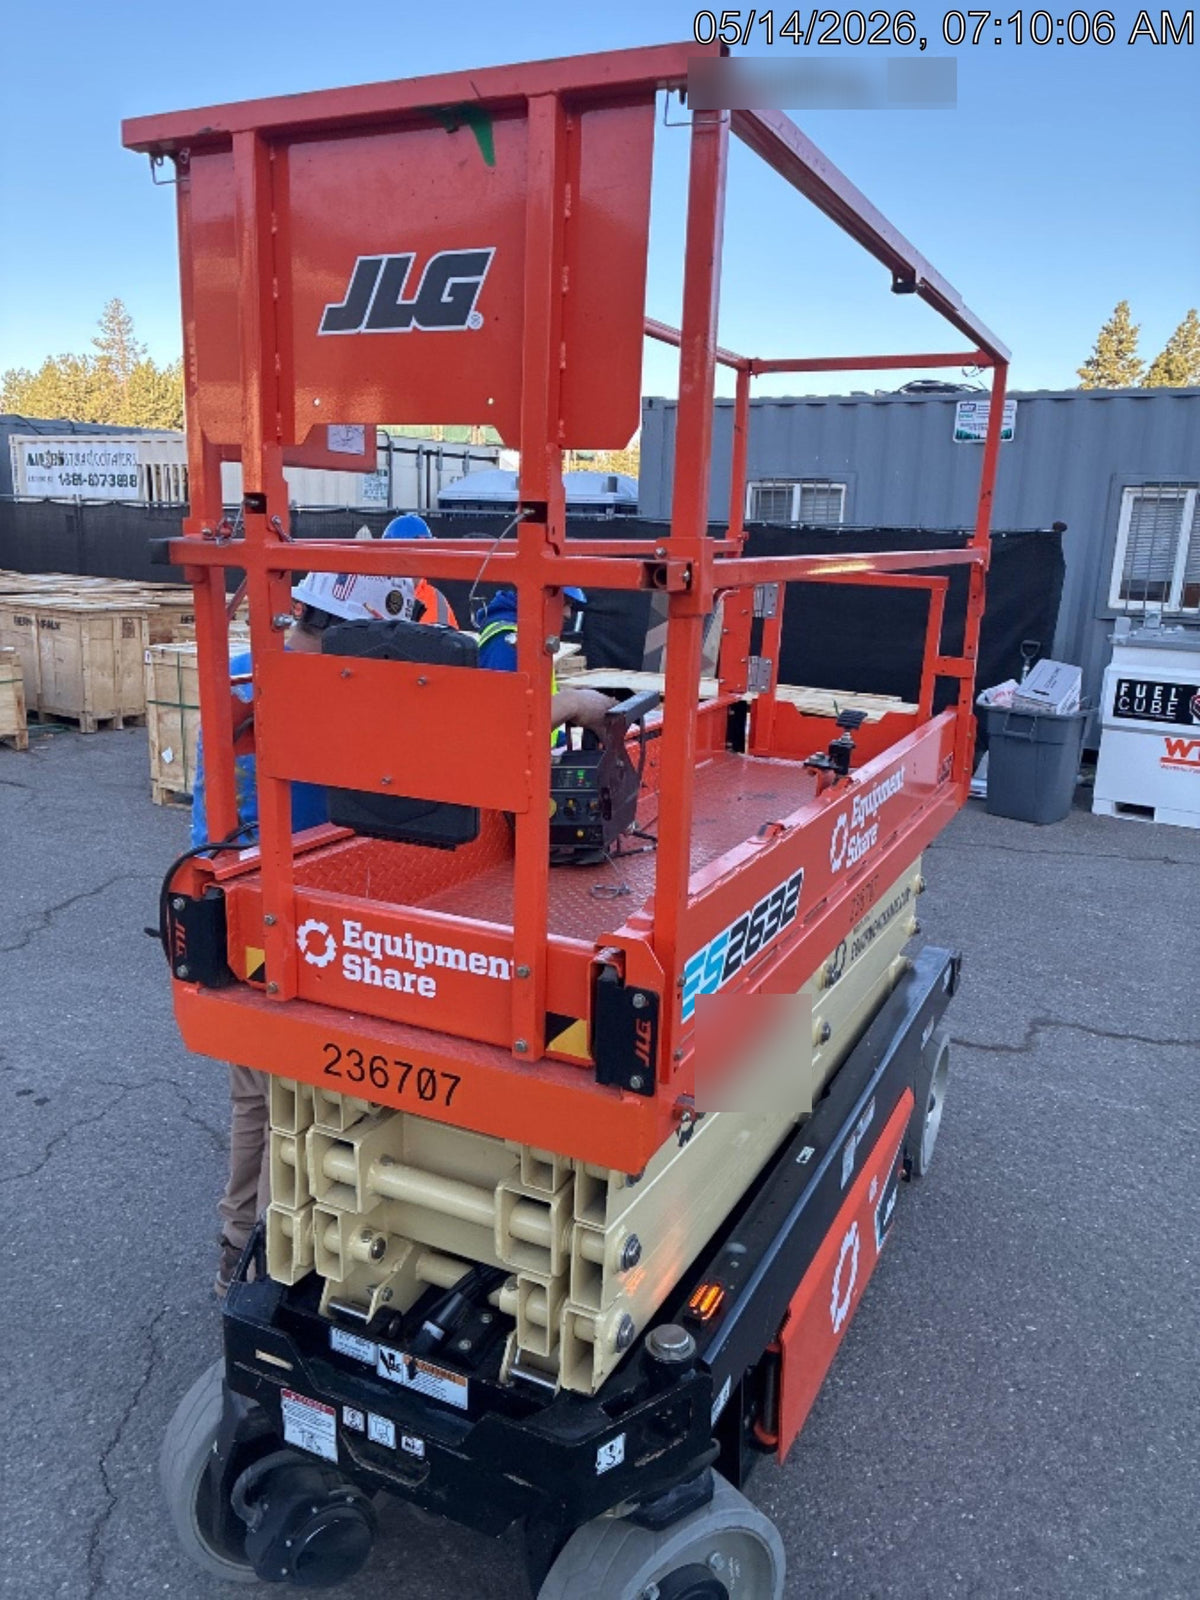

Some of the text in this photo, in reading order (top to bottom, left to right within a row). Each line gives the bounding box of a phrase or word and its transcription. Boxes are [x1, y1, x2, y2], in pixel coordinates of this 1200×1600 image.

[317, 247, 496, 336] JLG
[1117, 696, 1179, 716] CUBE
[1120, 682, 1179, 702] FUEL
[342, 918, 514, 981] Equipmen
[681, 867, 804, 1024] ES2632
[342, 952, 437, 999] Share
[635, 1017, 652, 1068] JLG
[322, 1042, 462, 1107] 236707
